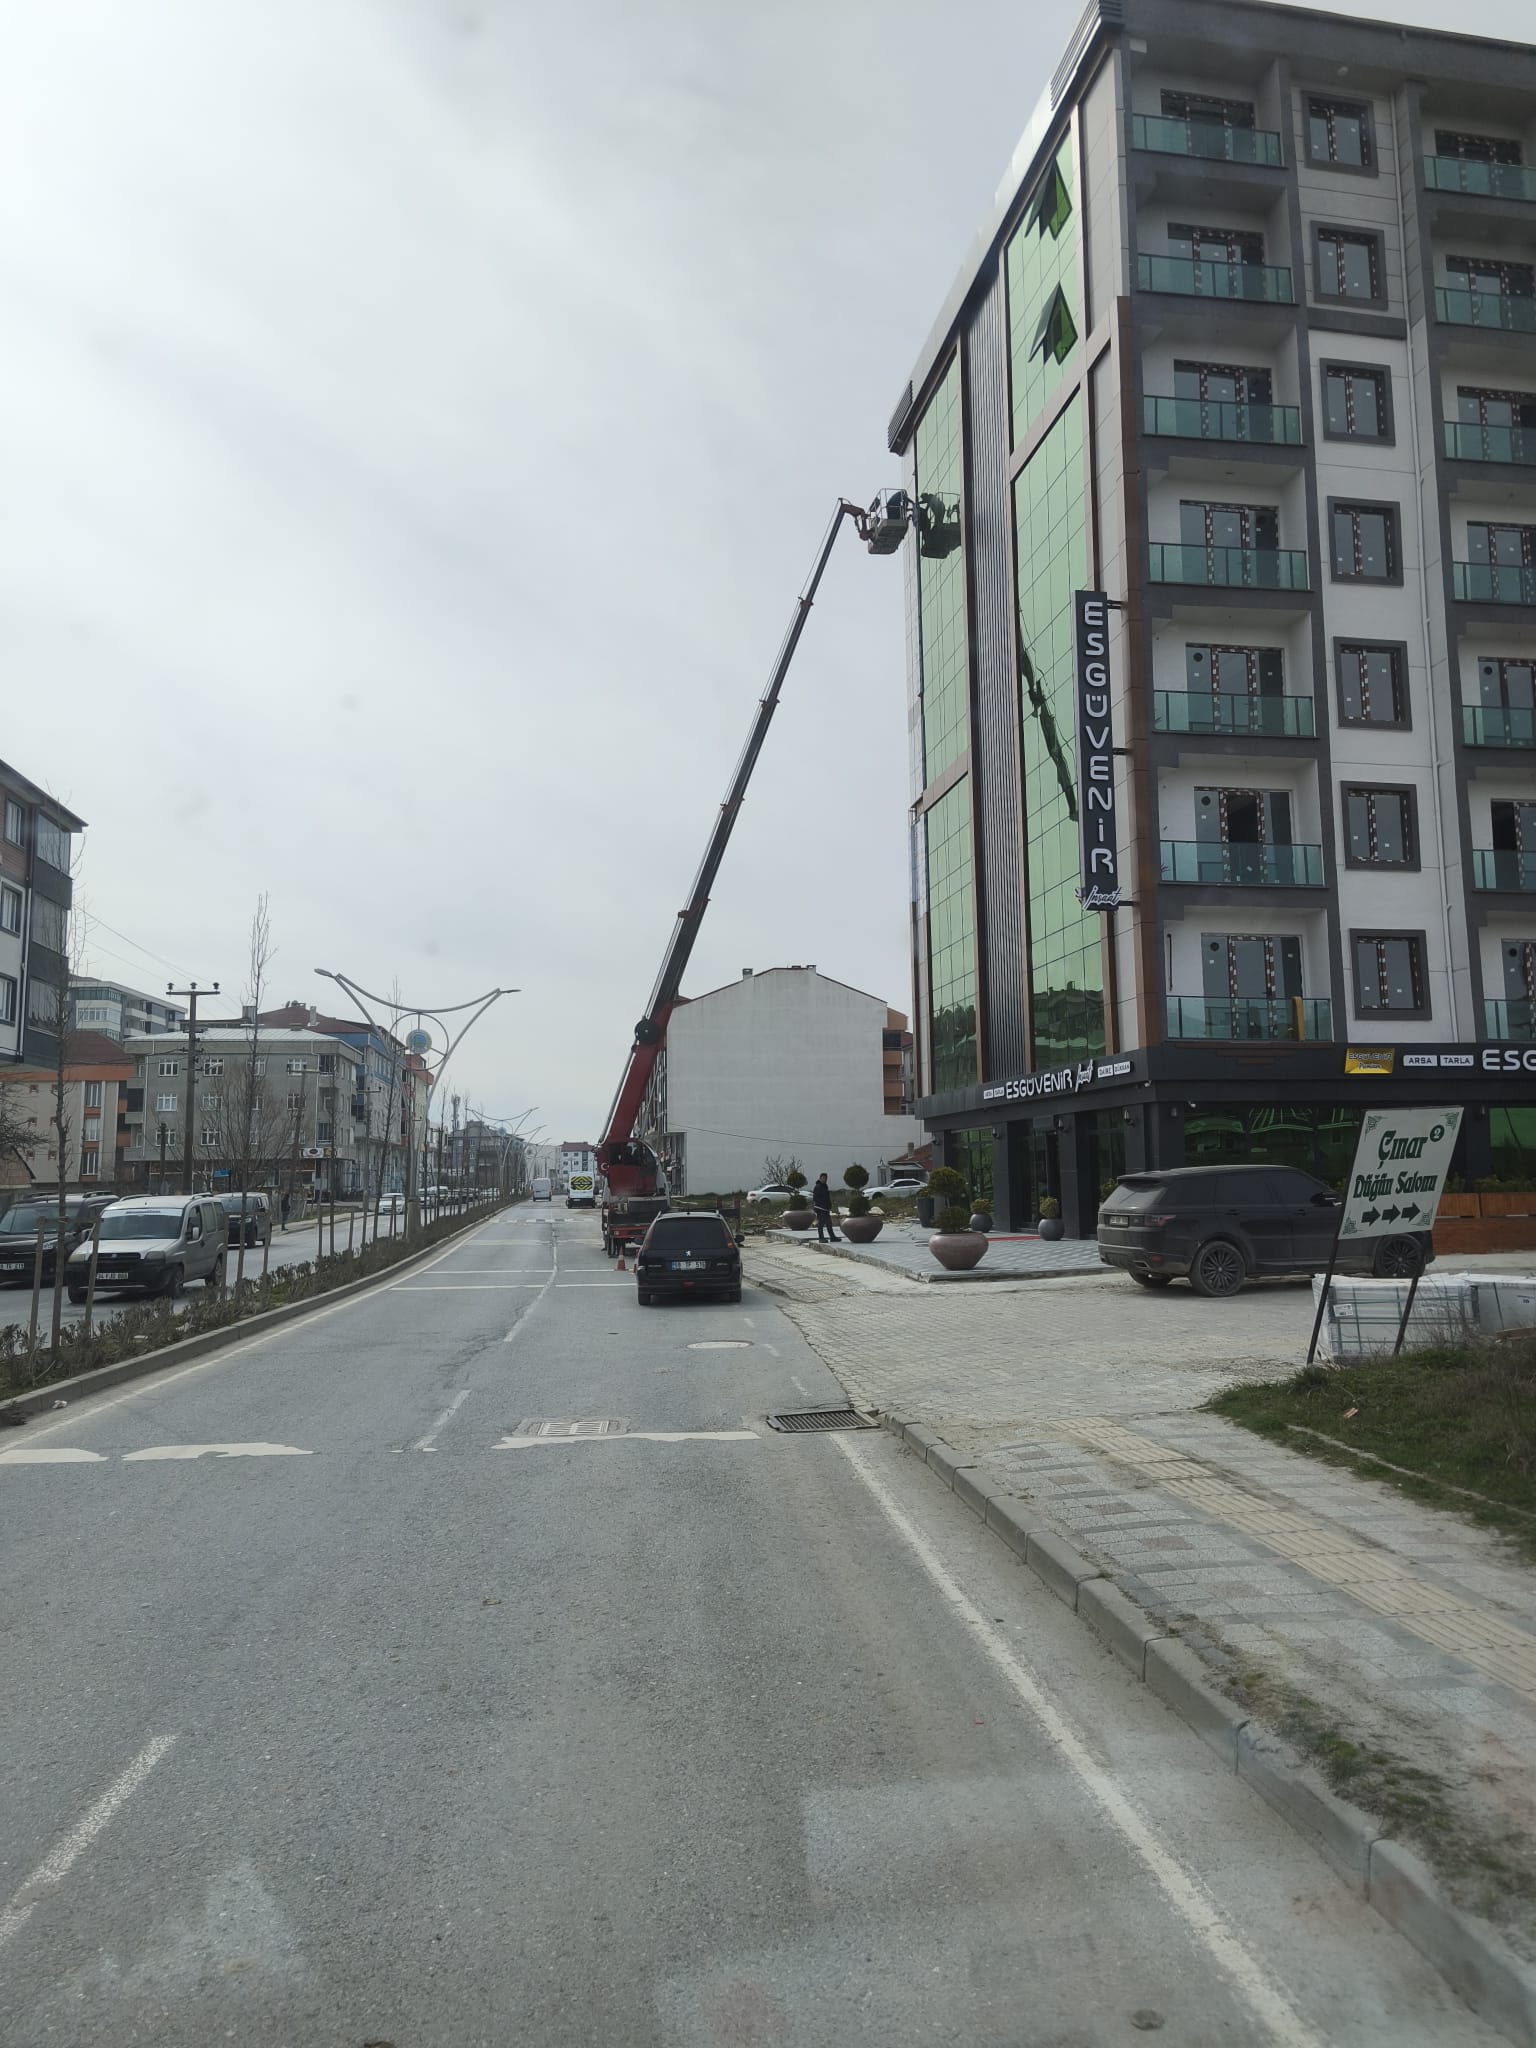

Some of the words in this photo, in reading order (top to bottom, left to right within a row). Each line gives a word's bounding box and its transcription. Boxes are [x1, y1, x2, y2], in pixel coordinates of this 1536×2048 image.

[1408, 1057, 1433, 1065] ARSA
[1443, 1057, 1471, 1065] TARLA
[1377, 1130, 1428, 1169] Çınar
[1353, 1173, 1394, 1201] Düğün
[1395, 1170, 1438, 1194] Salonu
